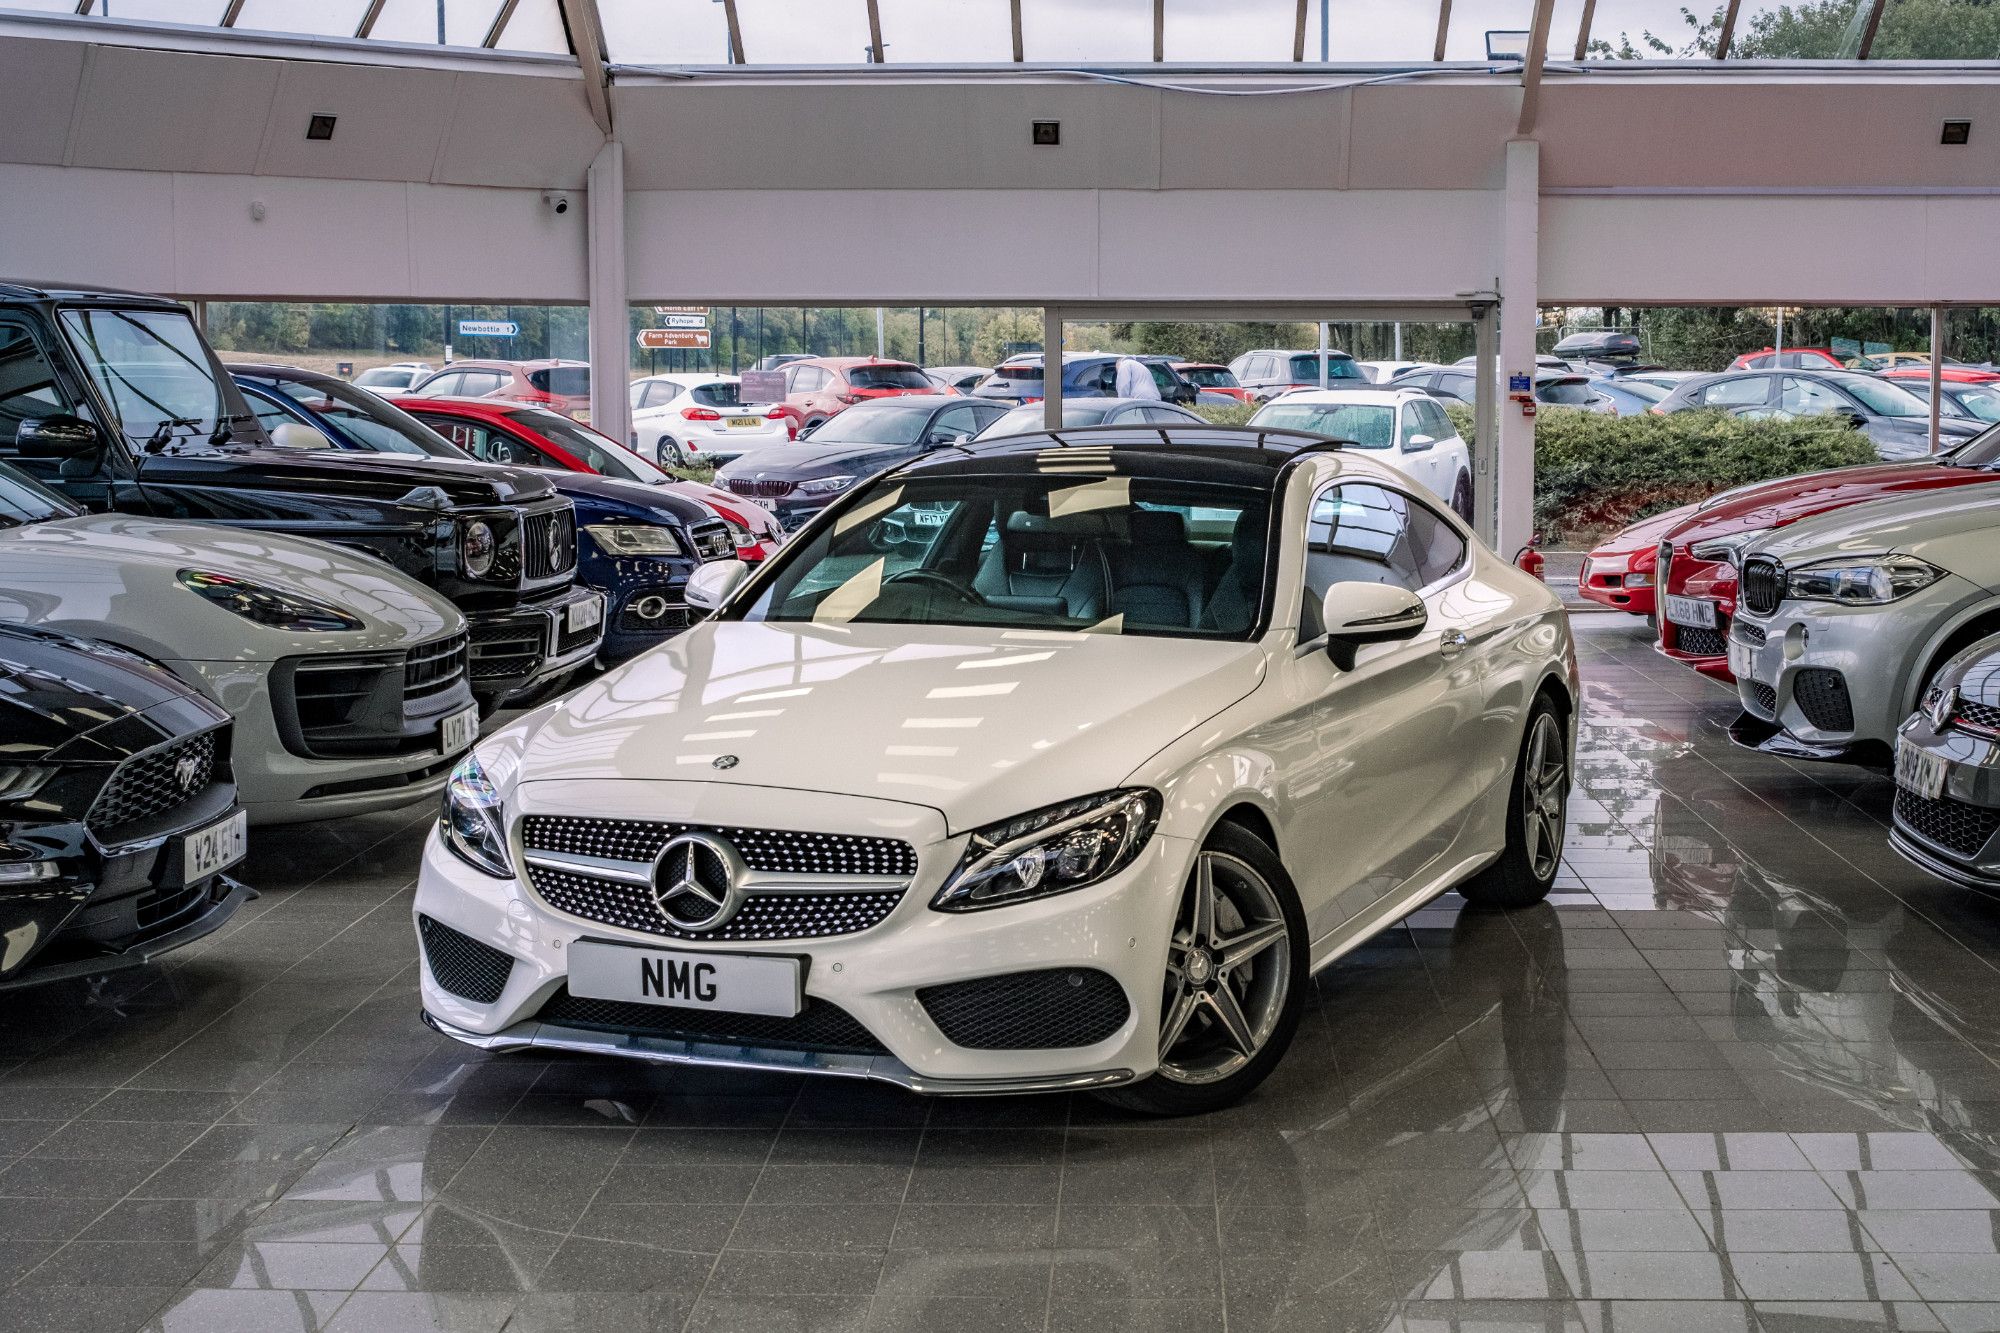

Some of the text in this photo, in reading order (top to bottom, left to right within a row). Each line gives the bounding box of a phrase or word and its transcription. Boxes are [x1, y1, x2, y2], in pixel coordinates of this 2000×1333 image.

[462, 325, 500, 333] Newbottle
[671, 317, 694, 325] Ryhope
[1691, 602, 1712, 624] HNC
[446, 715, 465, 748] LY74
[195, 829, 218, 873] V24
[641, 957, 717, 1002] NMG
